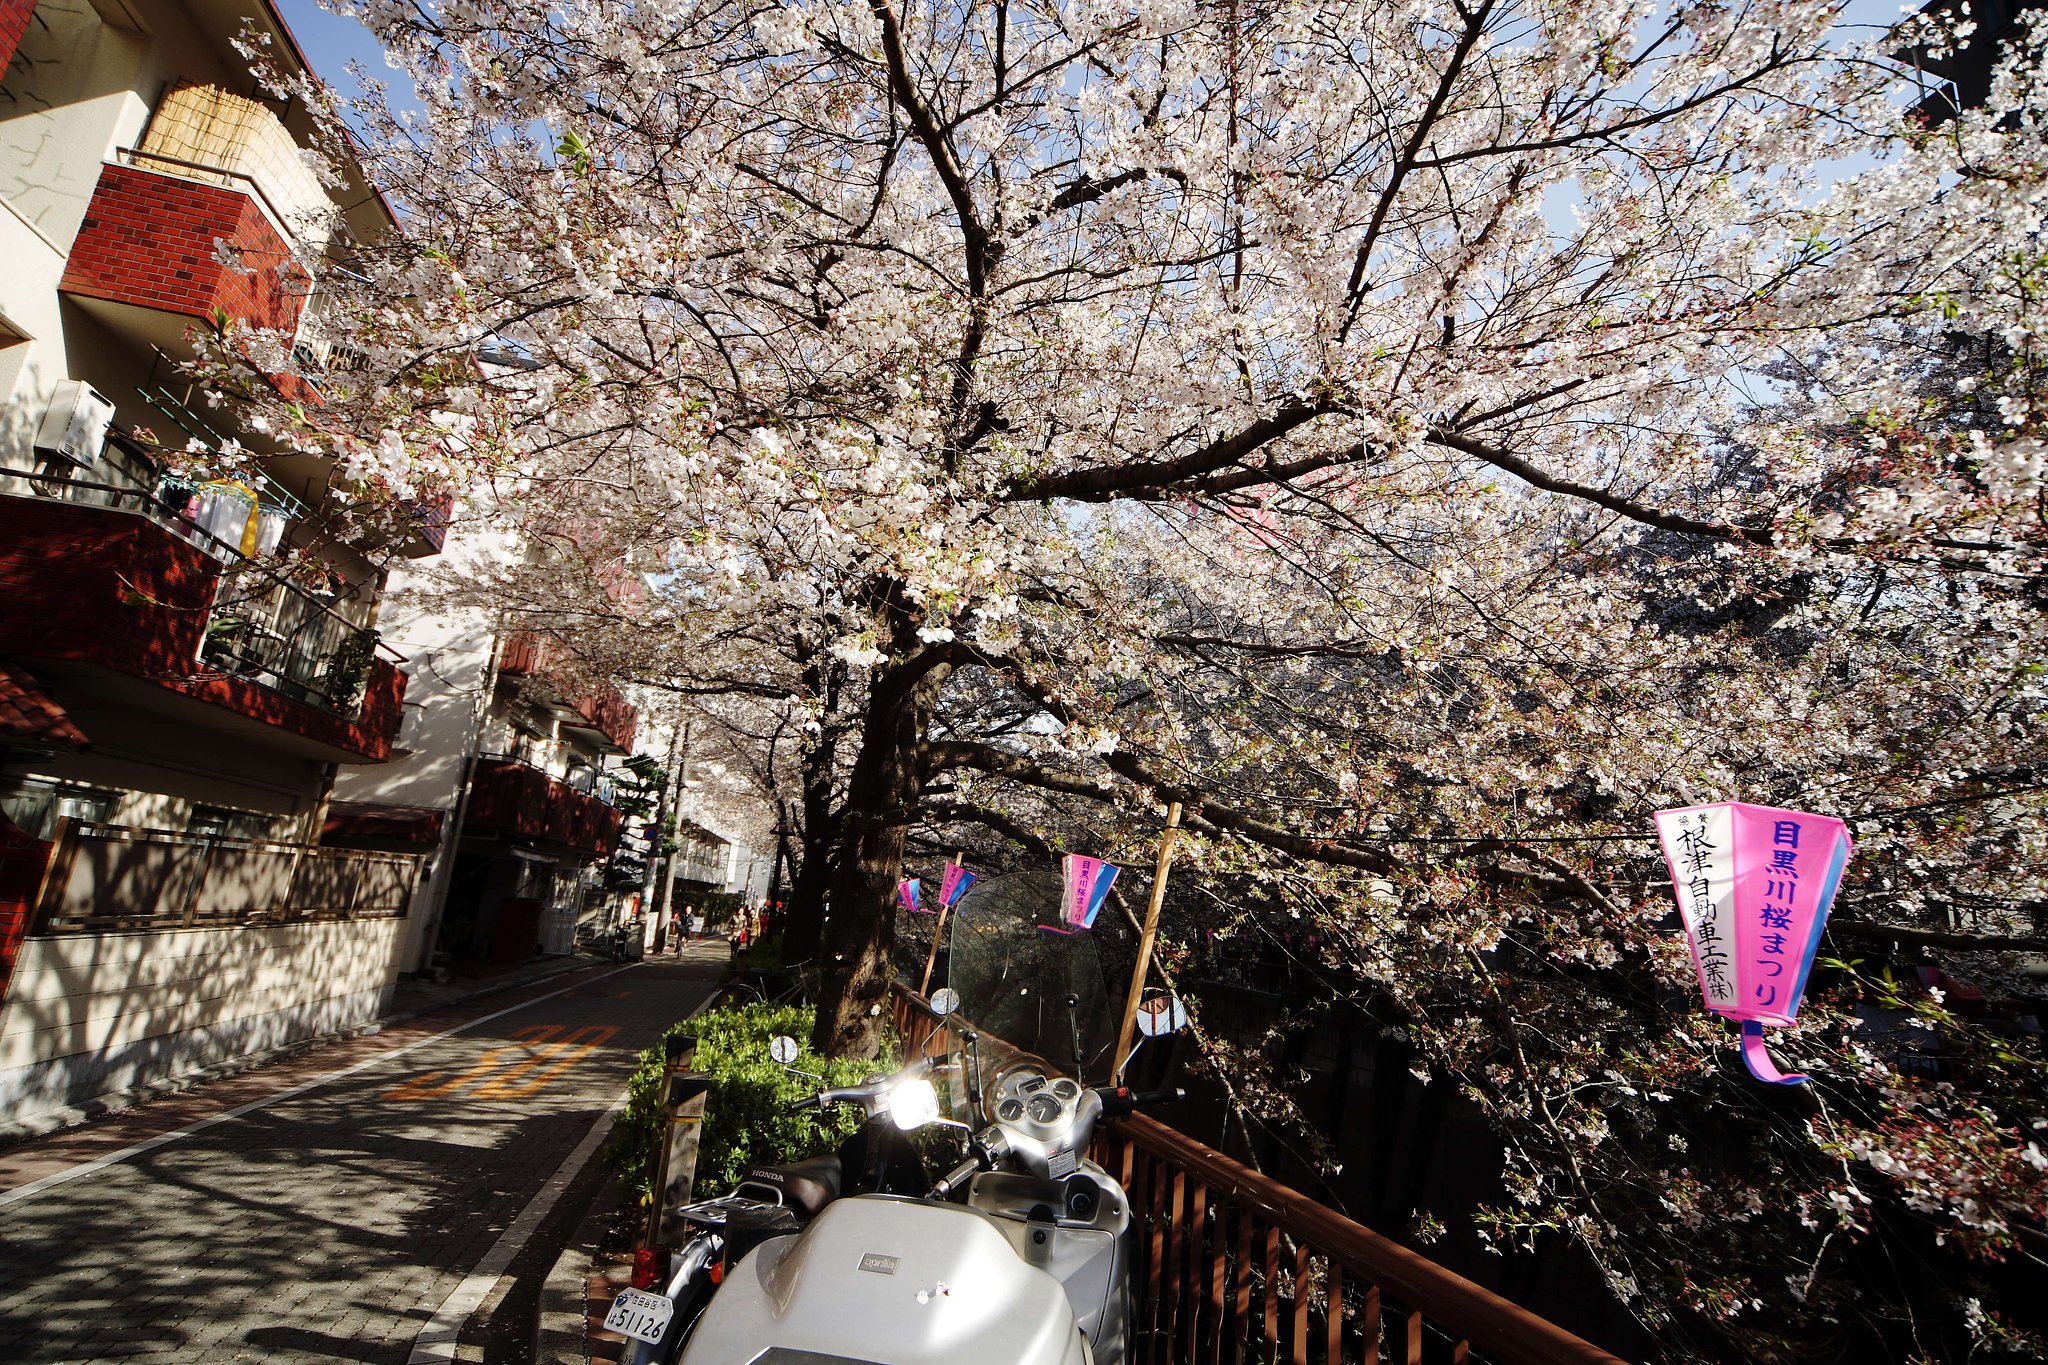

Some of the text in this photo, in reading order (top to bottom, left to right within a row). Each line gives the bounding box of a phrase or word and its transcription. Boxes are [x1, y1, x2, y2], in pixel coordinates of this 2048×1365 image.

[1755, 820, 1801, 1006] 目黒川桜まつり
[751, 1169, 784, 1182] HONDA
[616, 1309, 665, 1338] 51126
